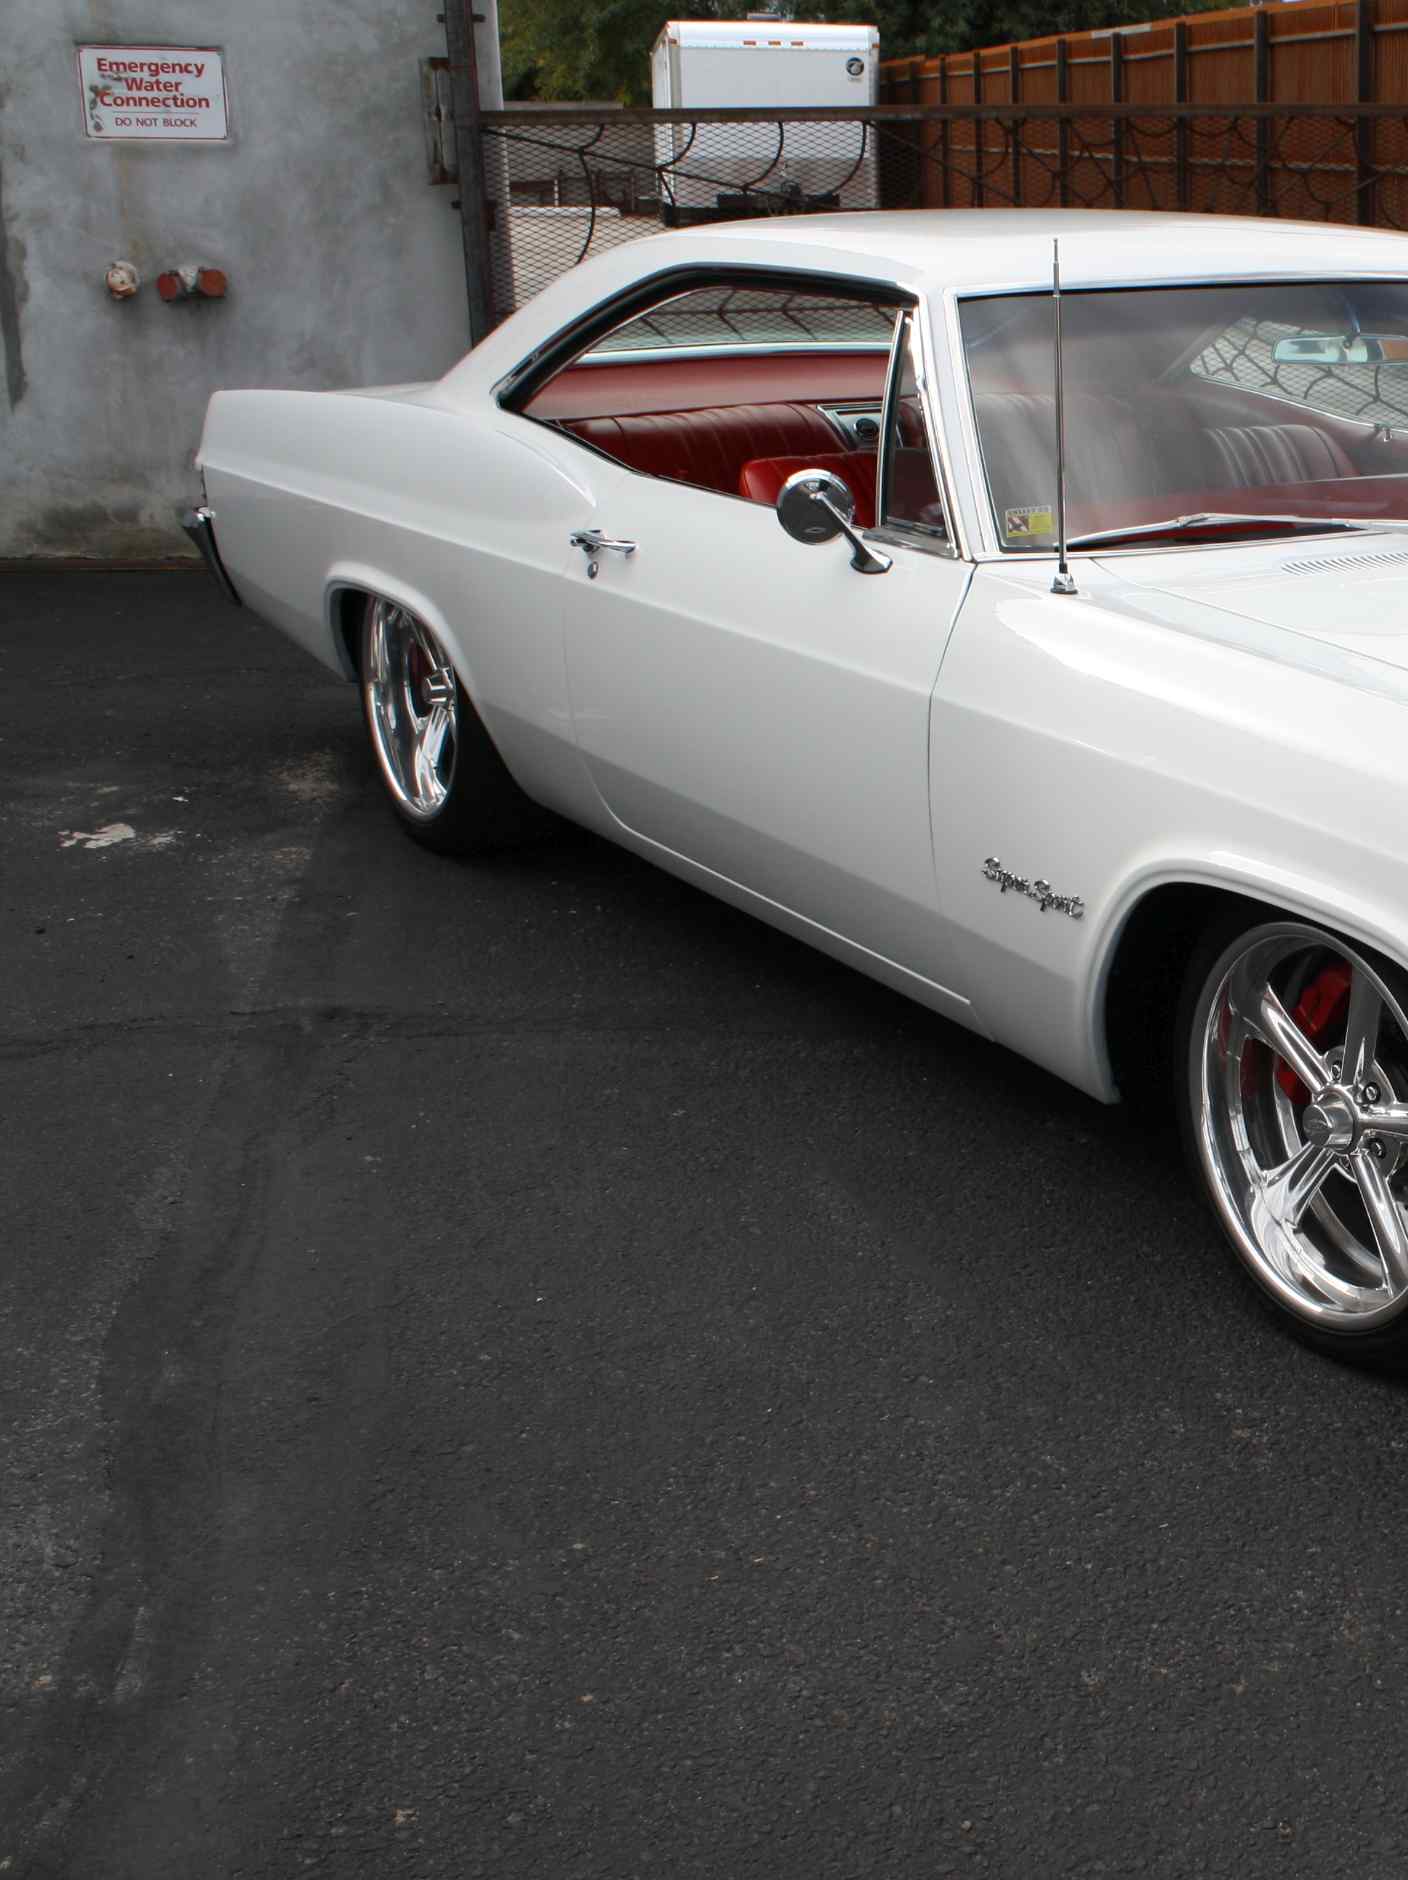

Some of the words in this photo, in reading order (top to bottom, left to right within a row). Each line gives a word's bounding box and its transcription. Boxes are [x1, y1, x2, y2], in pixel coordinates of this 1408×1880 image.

[96, 58, 205, 78] Emergency
[125, 77, 182, 92] Water
[99, 91, 210, 109] Connection
[115, 117, 132, 127] DO
[136, 117, 158, 127] NOT
[163, 117, 198, 128] BLOCK
[981, 857, 1030, 893] Super
[1026, 879, 1085, 920] Sport
